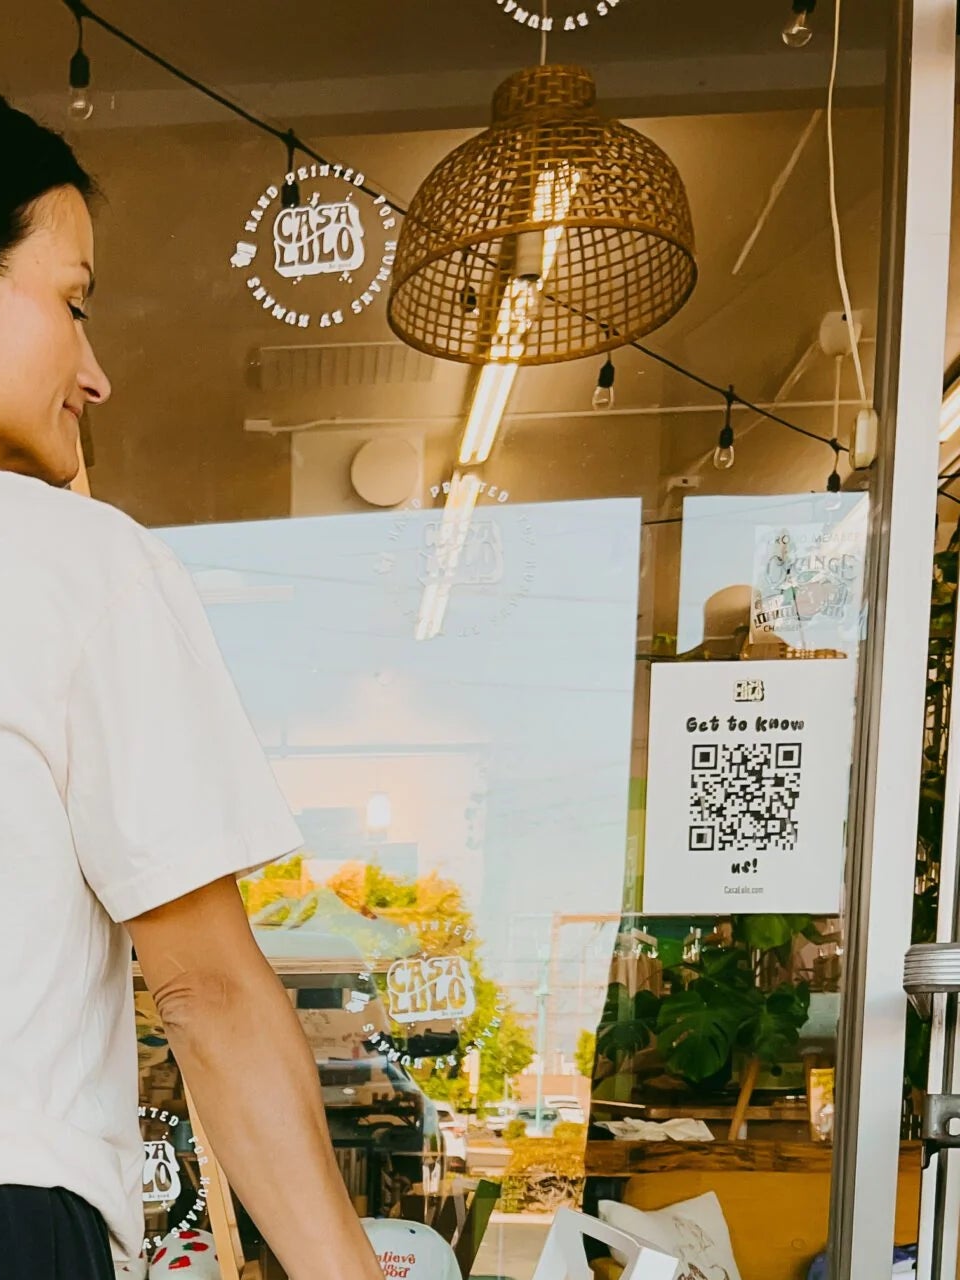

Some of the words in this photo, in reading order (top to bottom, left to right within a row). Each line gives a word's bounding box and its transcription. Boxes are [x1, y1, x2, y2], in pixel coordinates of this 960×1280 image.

[497, 0, 553, 31] HUMA
[563, 12, 589, 31] BY
[285, 164, 365, 186] PRINTED
[245, 185, 278, 232] HAND
[276, 205, 352, 244] CASA
[373, 194, 396, 230] FOR
[278, 227, 355, 268] LULO
[351, 241, 397, 314] HUMANS
[247, 276, 310, 328] HUMANS
[319, 310, 344, 328] BY
[686, 715, 720, 733] Get
[727, 715, 748, 732] to
[755, 716, 805, 733] know
[731, 857, 758, 874] us!
[391, 958, 464, 992] CASA
[391, 978, 466, 1013] LULO
[362, 1023, 423, 1069] HUMANS
[435, 1054, 457, 1070] BY
[188, 1136, 208, 1169] FOR
[171, 1176, 211, 1238] HUMANS
[142, 1235, 163, 1250] BY
